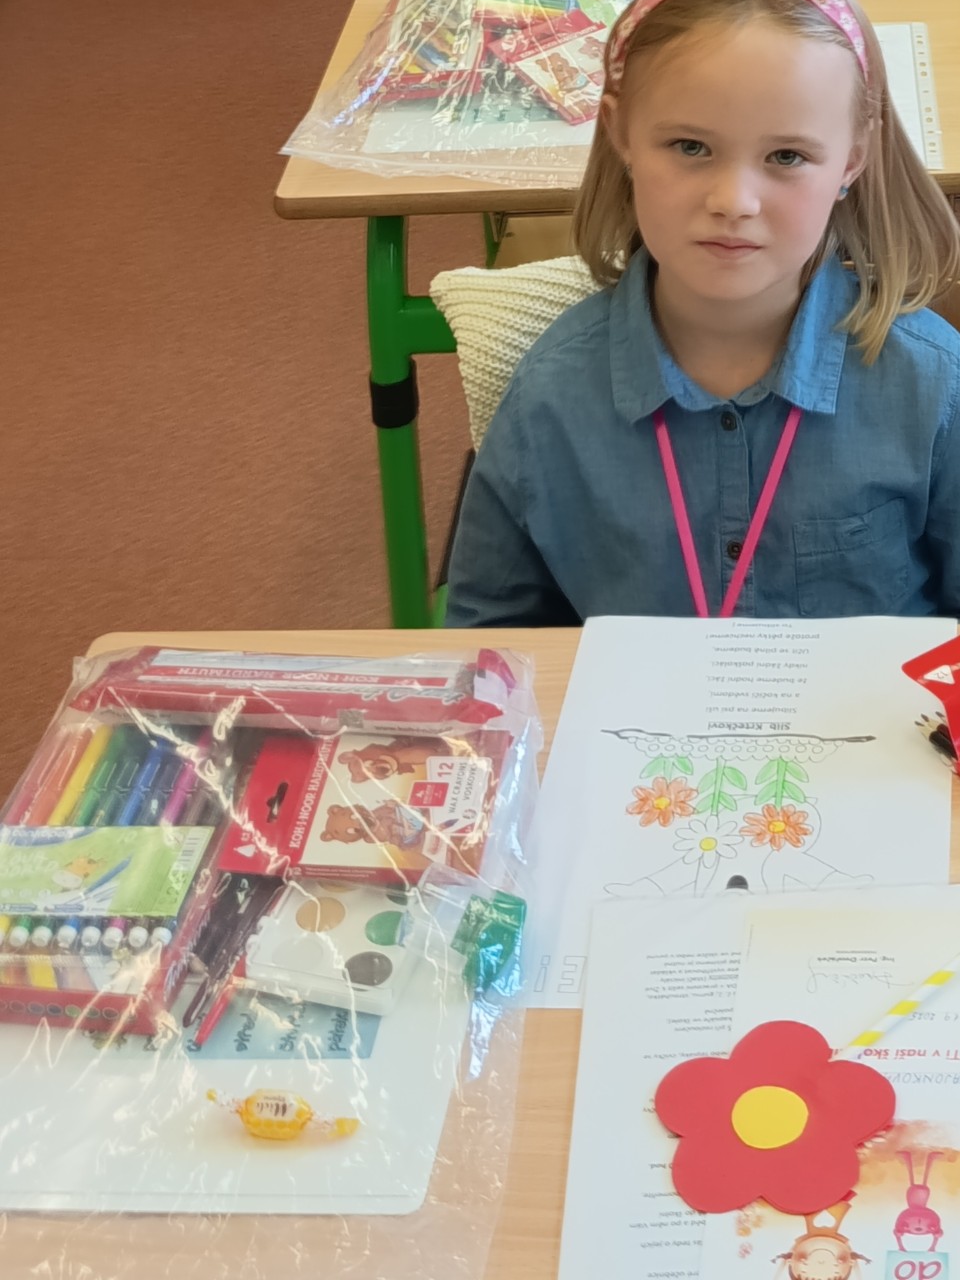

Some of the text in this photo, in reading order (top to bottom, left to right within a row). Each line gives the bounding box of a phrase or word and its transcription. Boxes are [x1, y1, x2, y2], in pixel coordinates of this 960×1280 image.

[707, 721, 791, 730] Slib Krtečkovi
[437, 763, 454, 777] 12
[894, 1048, 926, 1060] naší
[931, 1048, 939, 1057] v
[945, 1048, 960, 1060] Ti
